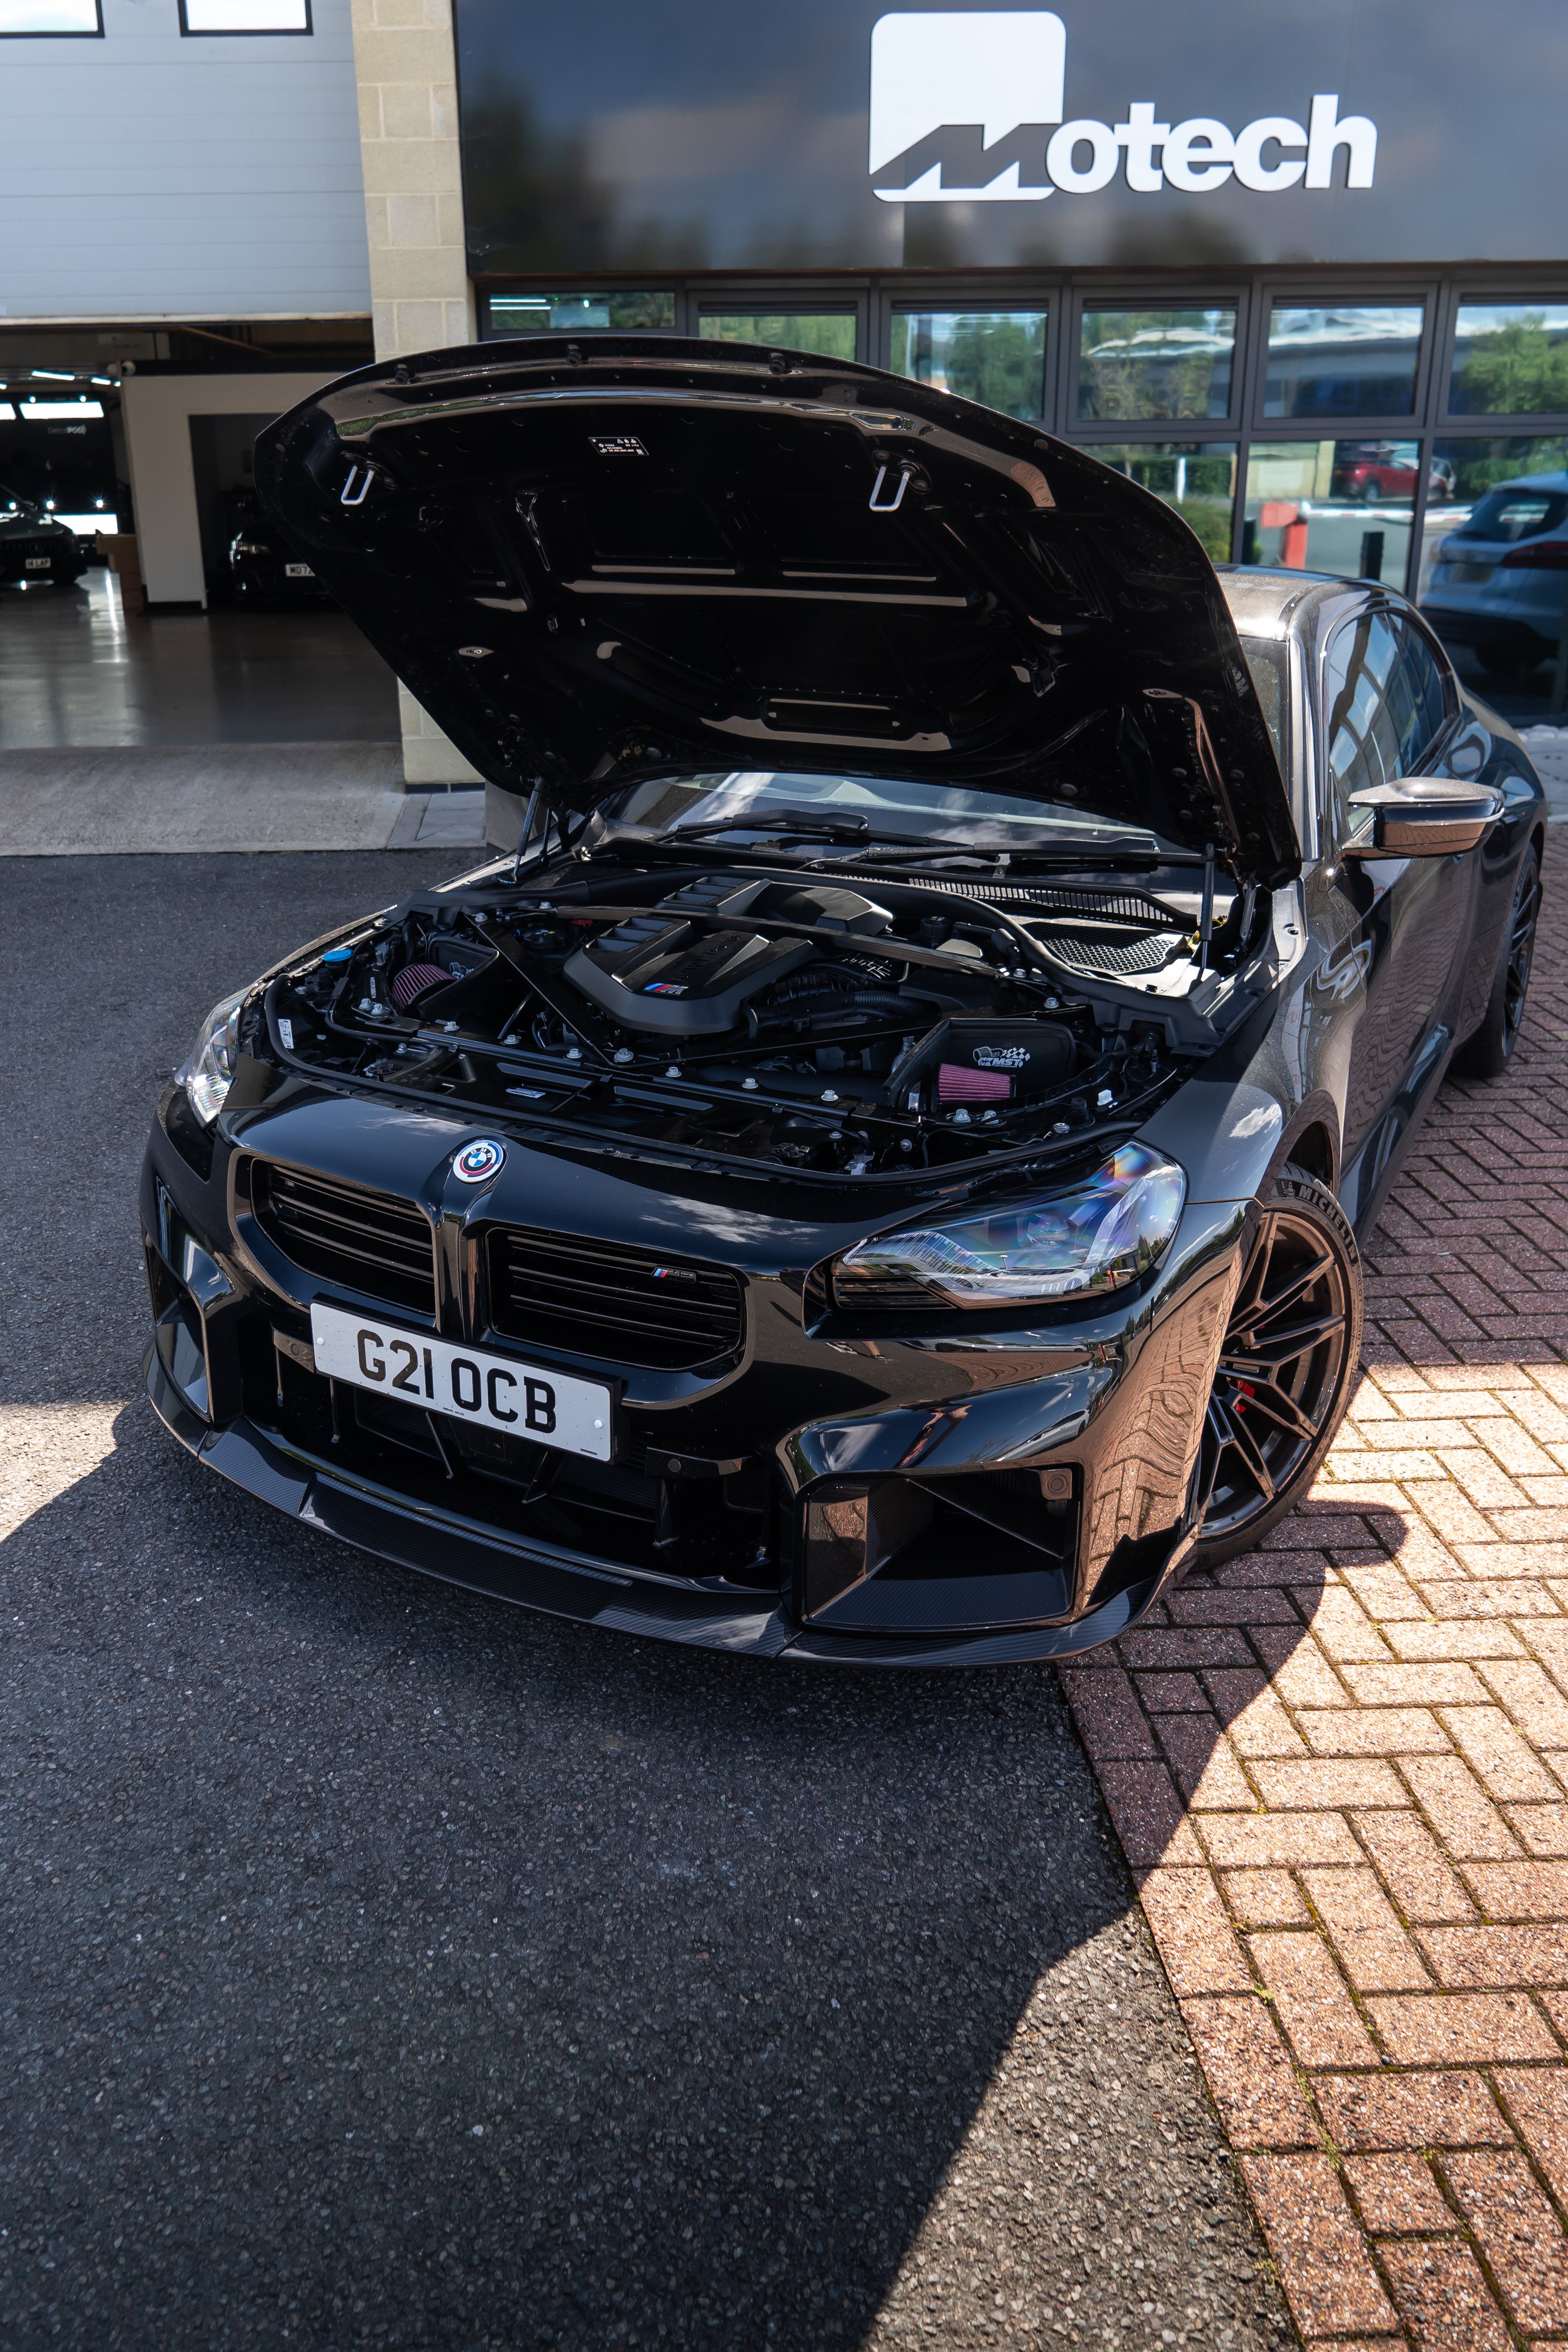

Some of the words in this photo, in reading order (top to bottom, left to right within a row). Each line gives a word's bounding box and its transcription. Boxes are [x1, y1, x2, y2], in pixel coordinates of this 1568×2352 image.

[992, 1058, 1021, 1066] MST
[470, 1147, 492, 1158] BMW
[1299, 1185, 1357, 1260] MICHELIN
[356, 1328, 435, 1400] G21
[450, 1358, 557, 1434] OCB
